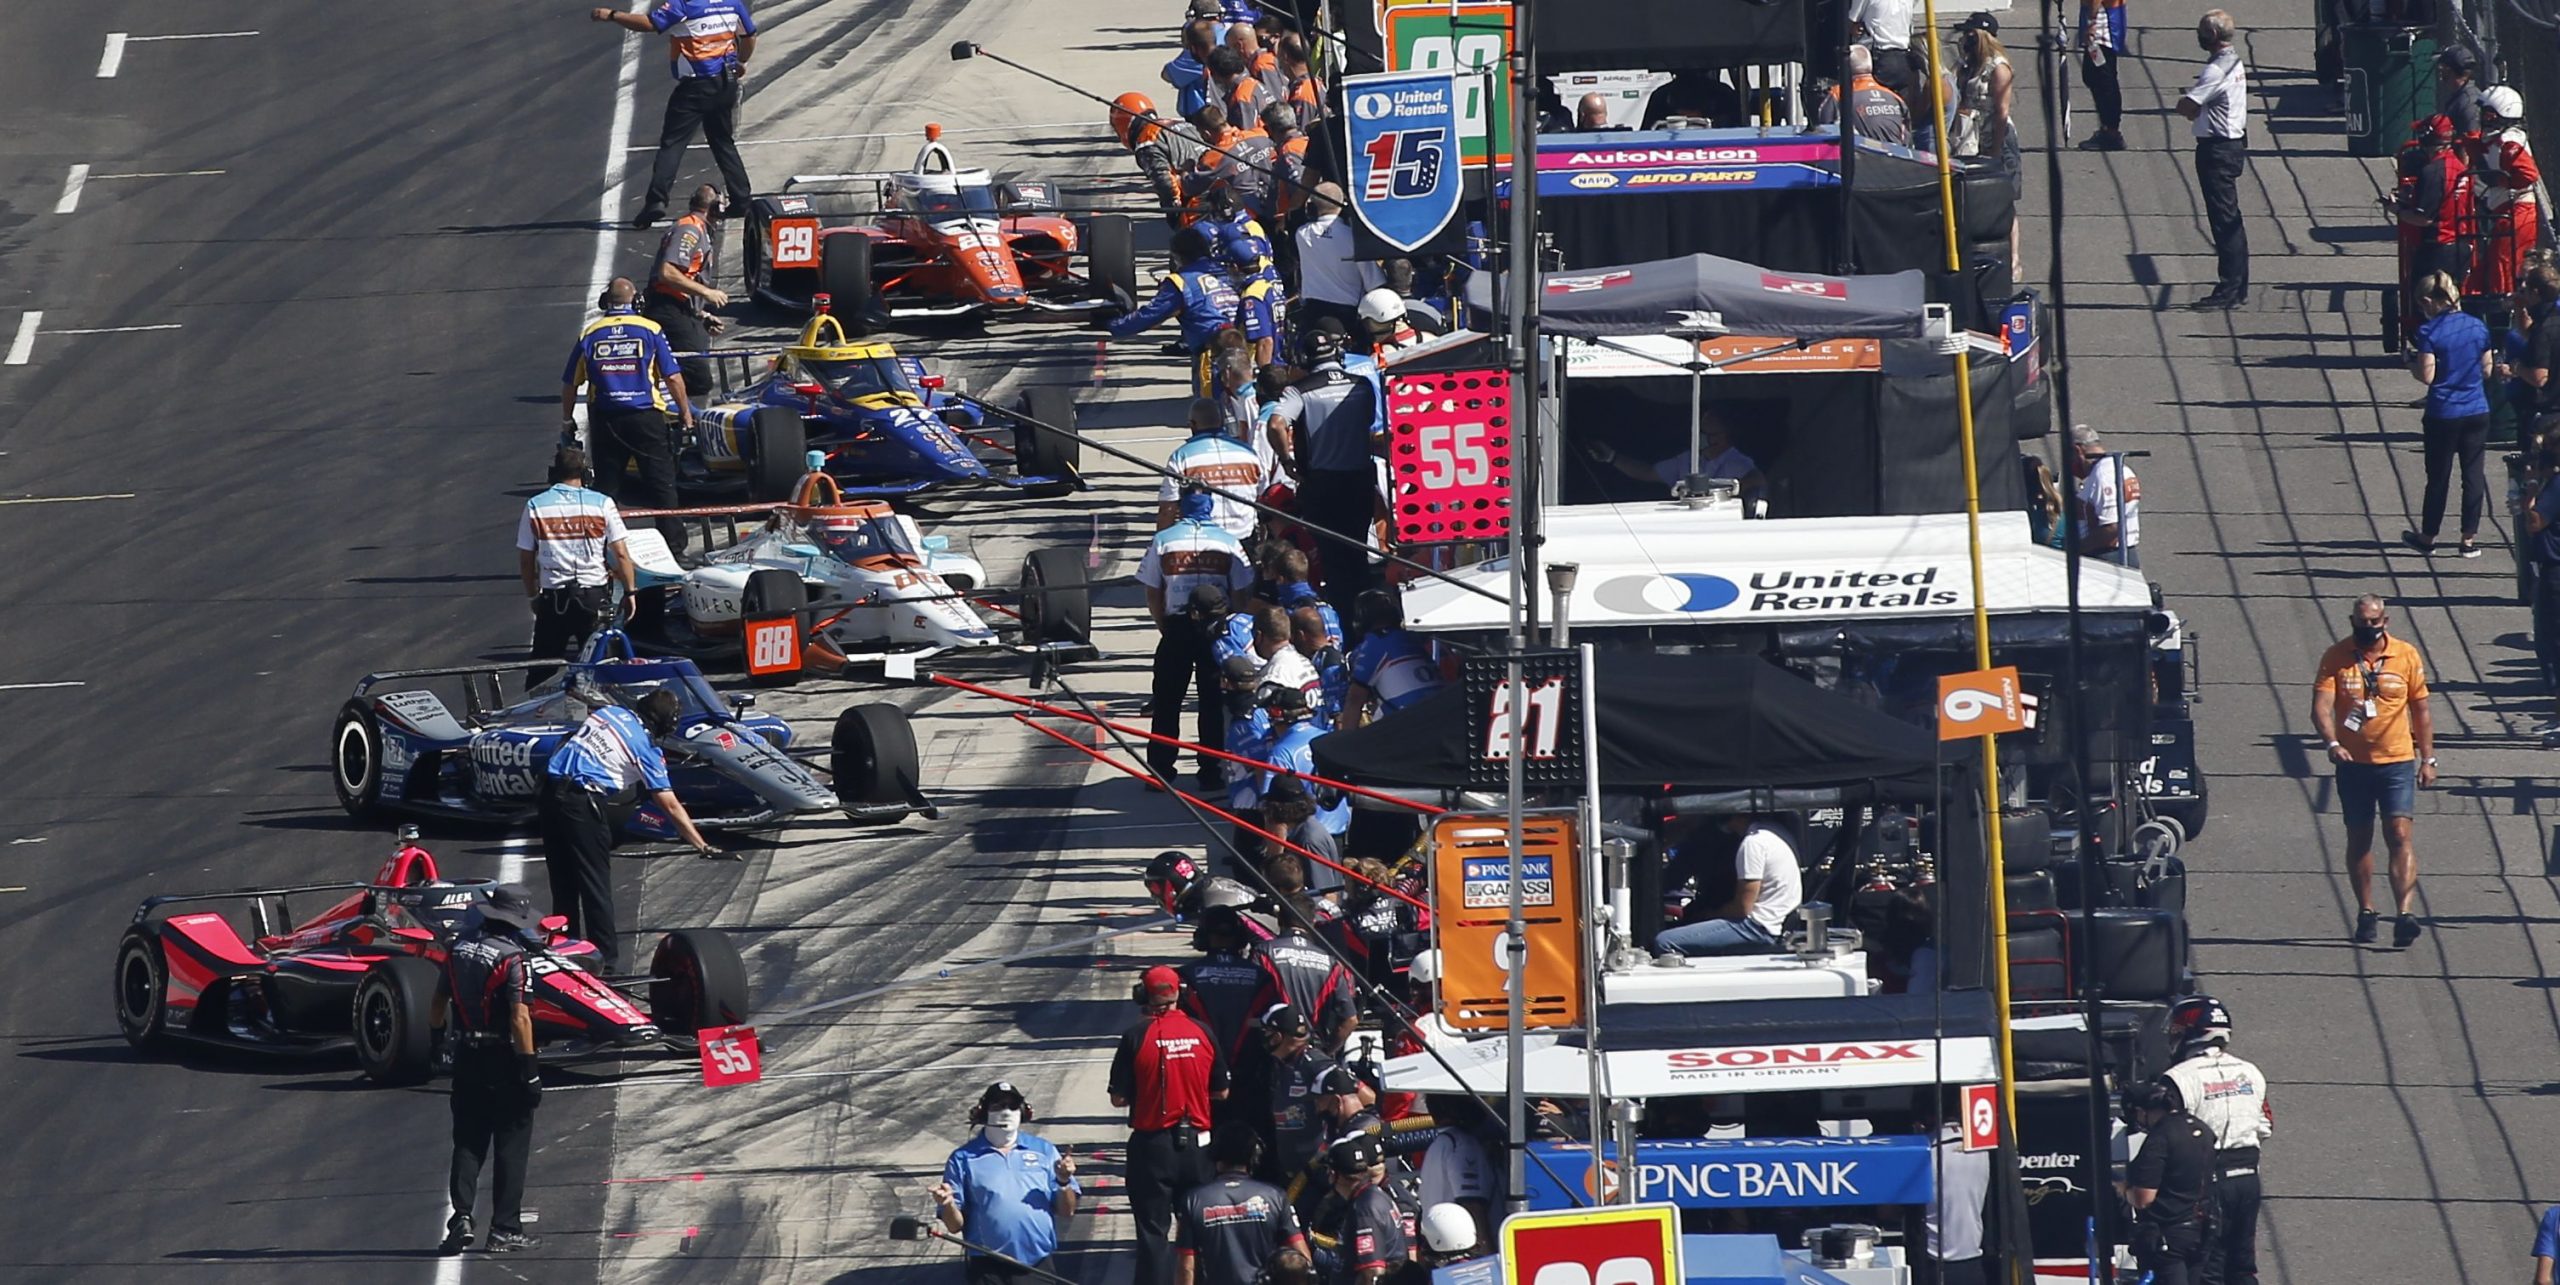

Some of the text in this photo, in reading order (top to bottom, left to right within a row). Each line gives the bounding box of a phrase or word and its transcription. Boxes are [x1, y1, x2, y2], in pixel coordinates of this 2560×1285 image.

[1393, 89, 1443, 104] United
[1394, 102, 1448, 117] Rentals
[1363, 127, 1446, 202] 15
[1568, 149, 1757, 165] AutoNation
[1578, 170, 1757, 186] NAPA AUTO PARTS
[777, 227, 813, 262] 29
[1709, 345, 1876, 356] GLENERS
[1420, 422, 1490, 490] 55
[1749, 567, 1938, 590] United
[1749, 587, 1959, 611] Rentals
[754, 625, 792, 667] 88
[2001, 677, 2017, 722] DIXON
[1486, 675, 1567, 762] 21
[469, 732, 541, 767] United
[585, 735, 607, 761] Rentals
[591, 729, 614, 753] United
[640, 813, 662, 827] TOTAL
[1520, 862, 1550, 876] ANK
[441, 892, 473, 905] ALEX
[1467, 895, 1550, 905] RACNG
[1482, 881, 1550, 896] GASSI
[532, 956, 583, 974] 55
[705, 1038, 752, 1075] 55
[1667, 1043, 1926, 1068] SONAX
[1670, 1072, 1719, 1080] MADE
[1754, 1067, 1842, 1077] GERMANY
[1636, 1140, 1733, 1149] NC
[1637, 1161, 1860, 1199] PNC BANK
